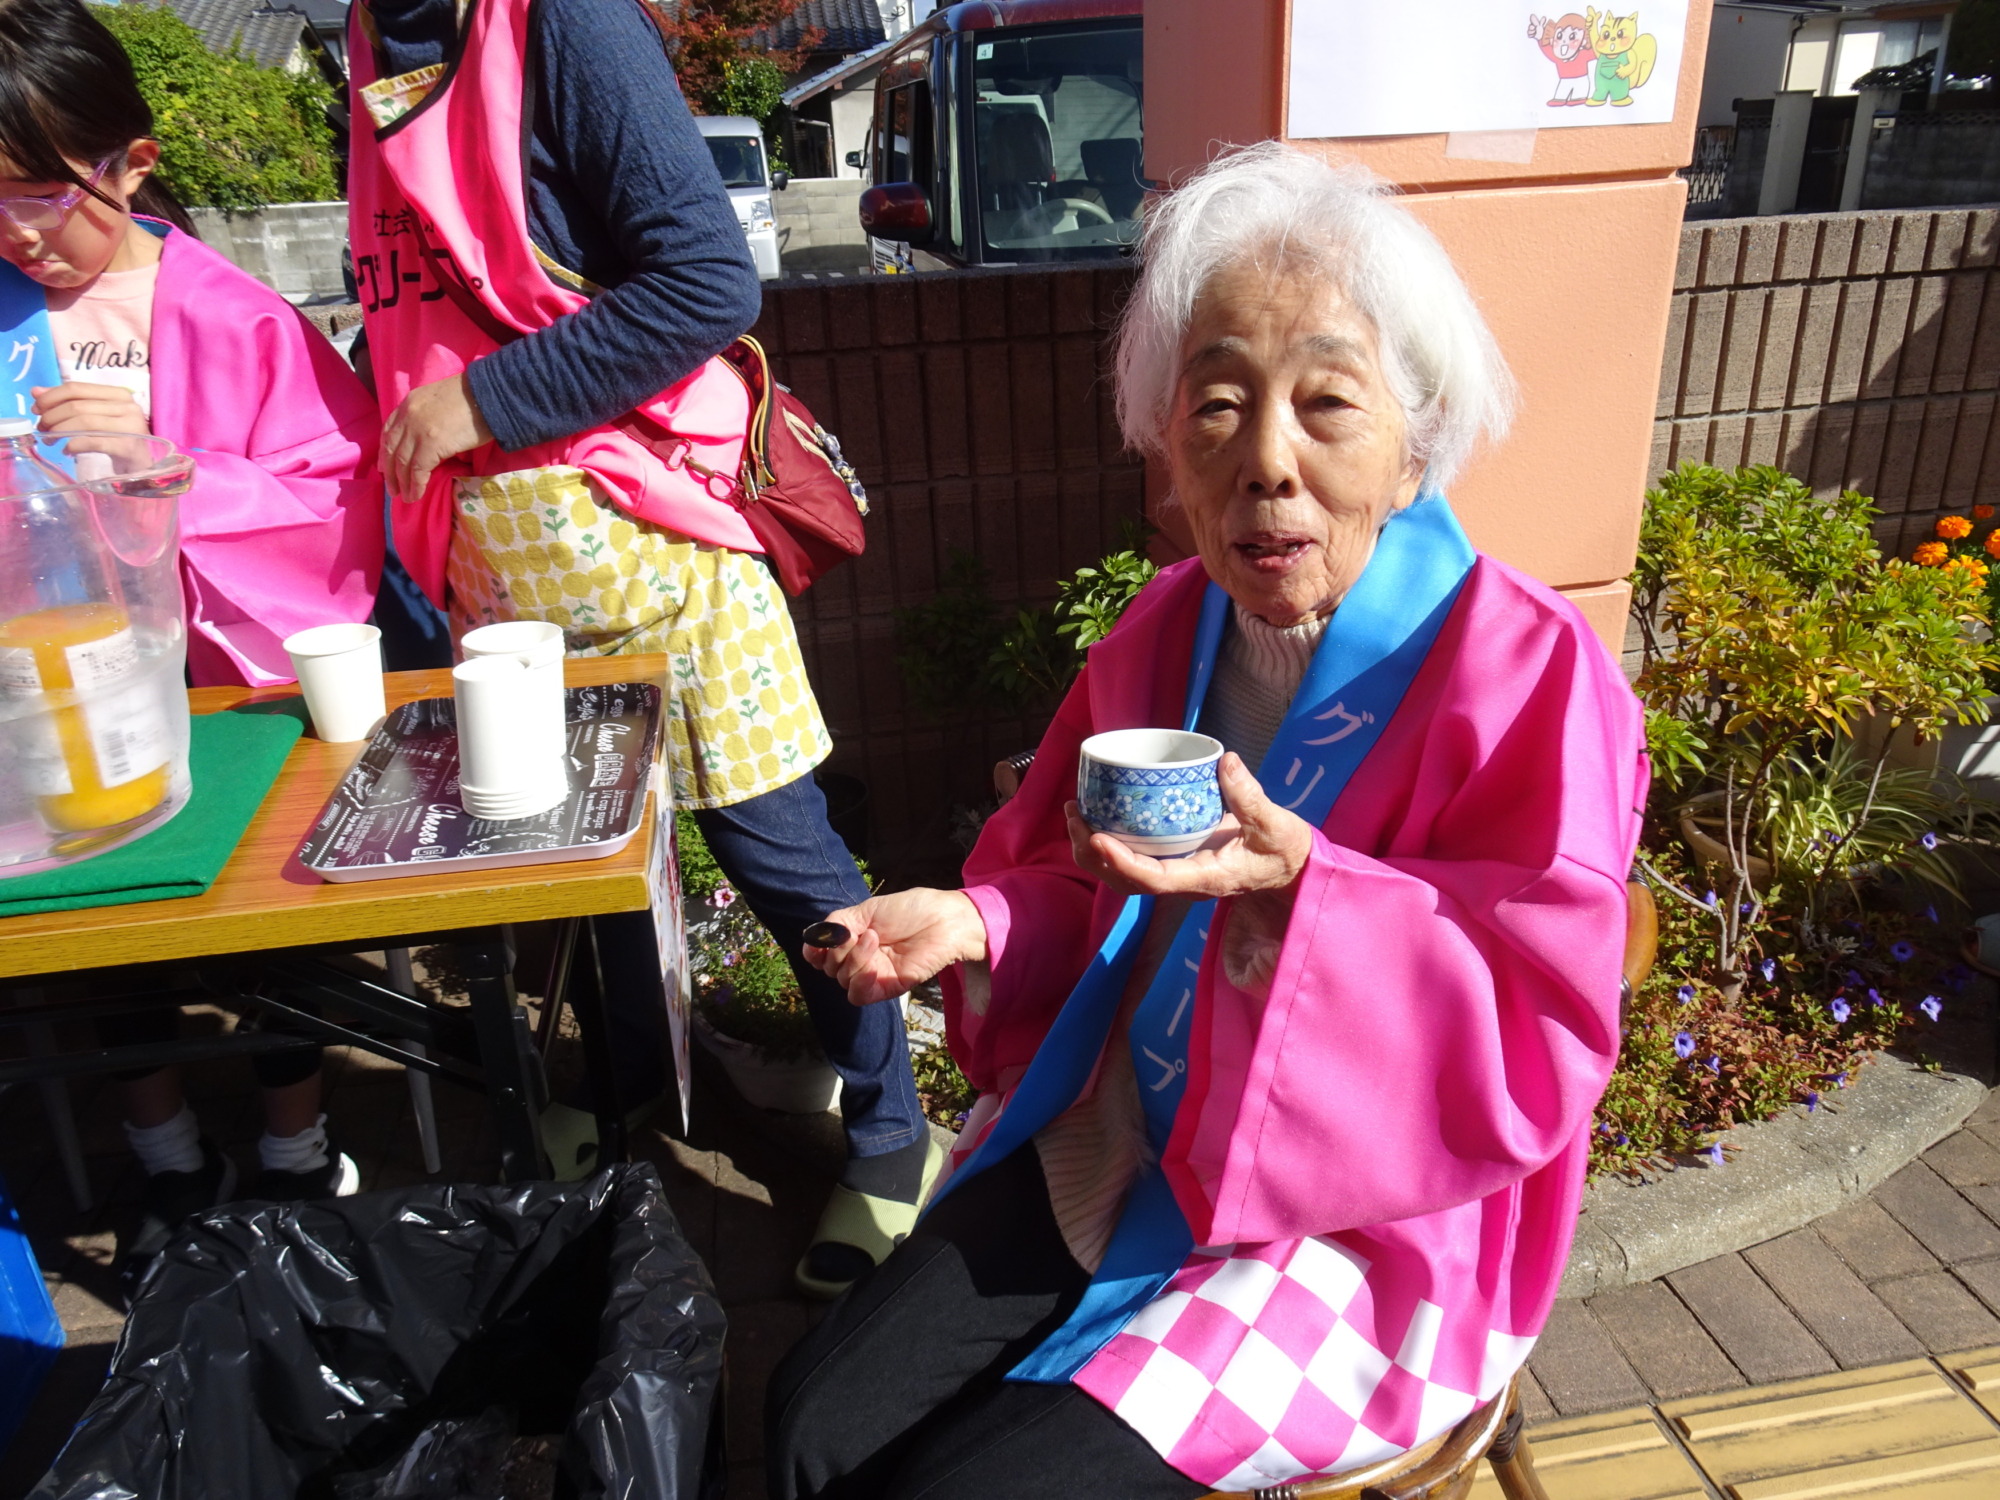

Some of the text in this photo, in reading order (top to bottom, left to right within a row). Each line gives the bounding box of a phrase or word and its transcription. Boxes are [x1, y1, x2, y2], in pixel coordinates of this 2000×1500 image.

[69, 339, 150, 371] Mak
[609, 698, 625, 718] eggs
[589, 722, 632, 788] Cheese CAKE
[418, 803, 463, 845] Cheese
[592, 789, 614, 829] 1/4 cup sugar
[581, 834, 600, 842] 2
